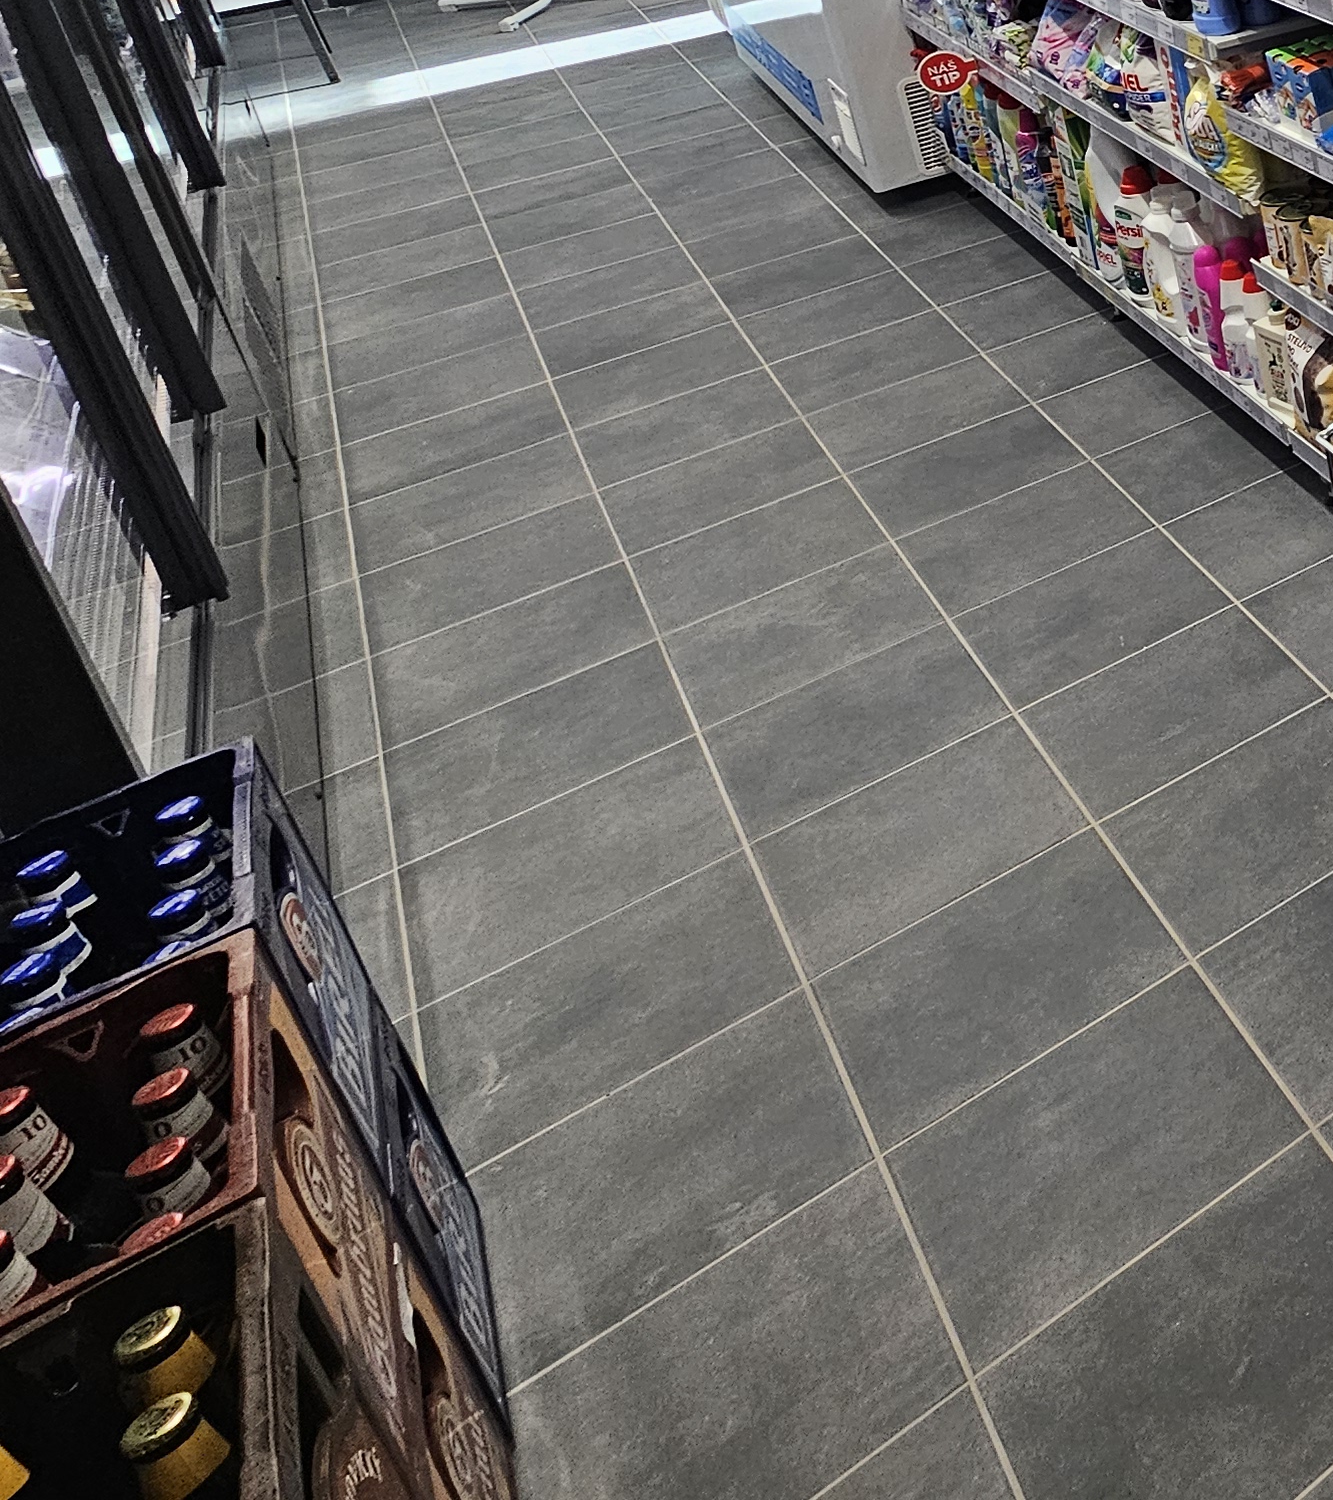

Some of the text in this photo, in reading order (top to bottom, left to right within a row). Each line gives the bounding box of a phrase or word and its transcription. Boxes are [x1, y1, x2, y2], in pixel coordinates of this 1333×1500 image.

[926, 57, 959, 78] NÁŠ
[932, 69, 962, 88] TIP
[1114, 221, 1145, 239] Persil
